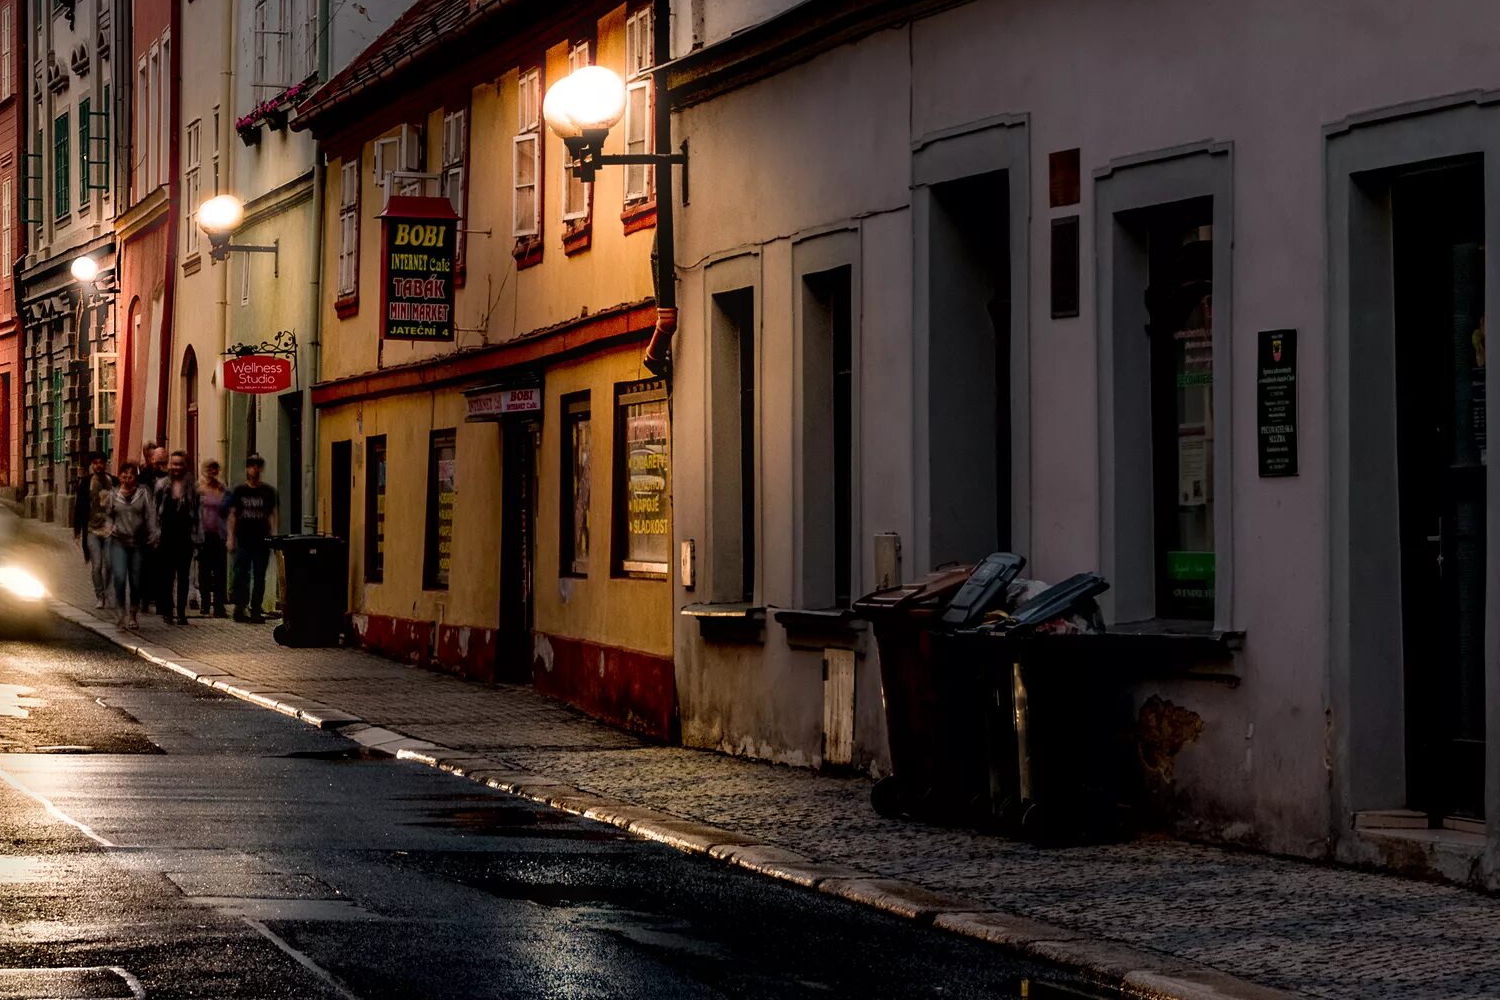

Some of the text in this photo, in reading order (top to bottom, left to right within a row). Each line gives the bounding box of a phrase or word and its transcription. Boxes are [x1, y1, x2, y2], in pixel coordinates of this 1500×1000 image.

[395, 223, 446, 247] BOBI
[391, 253, 450, 272] INTERNET Café
[393, 274, 445, 300] TABÁK
[390, 302, 449, 323] MINI MARKET
[390, 325, 449, 336] JATEČNÍ 4
[232, 362, 282, 374] Wellness
[239, 373, 275, 384] Studio
[510, 390, 534, 402] BOBI
